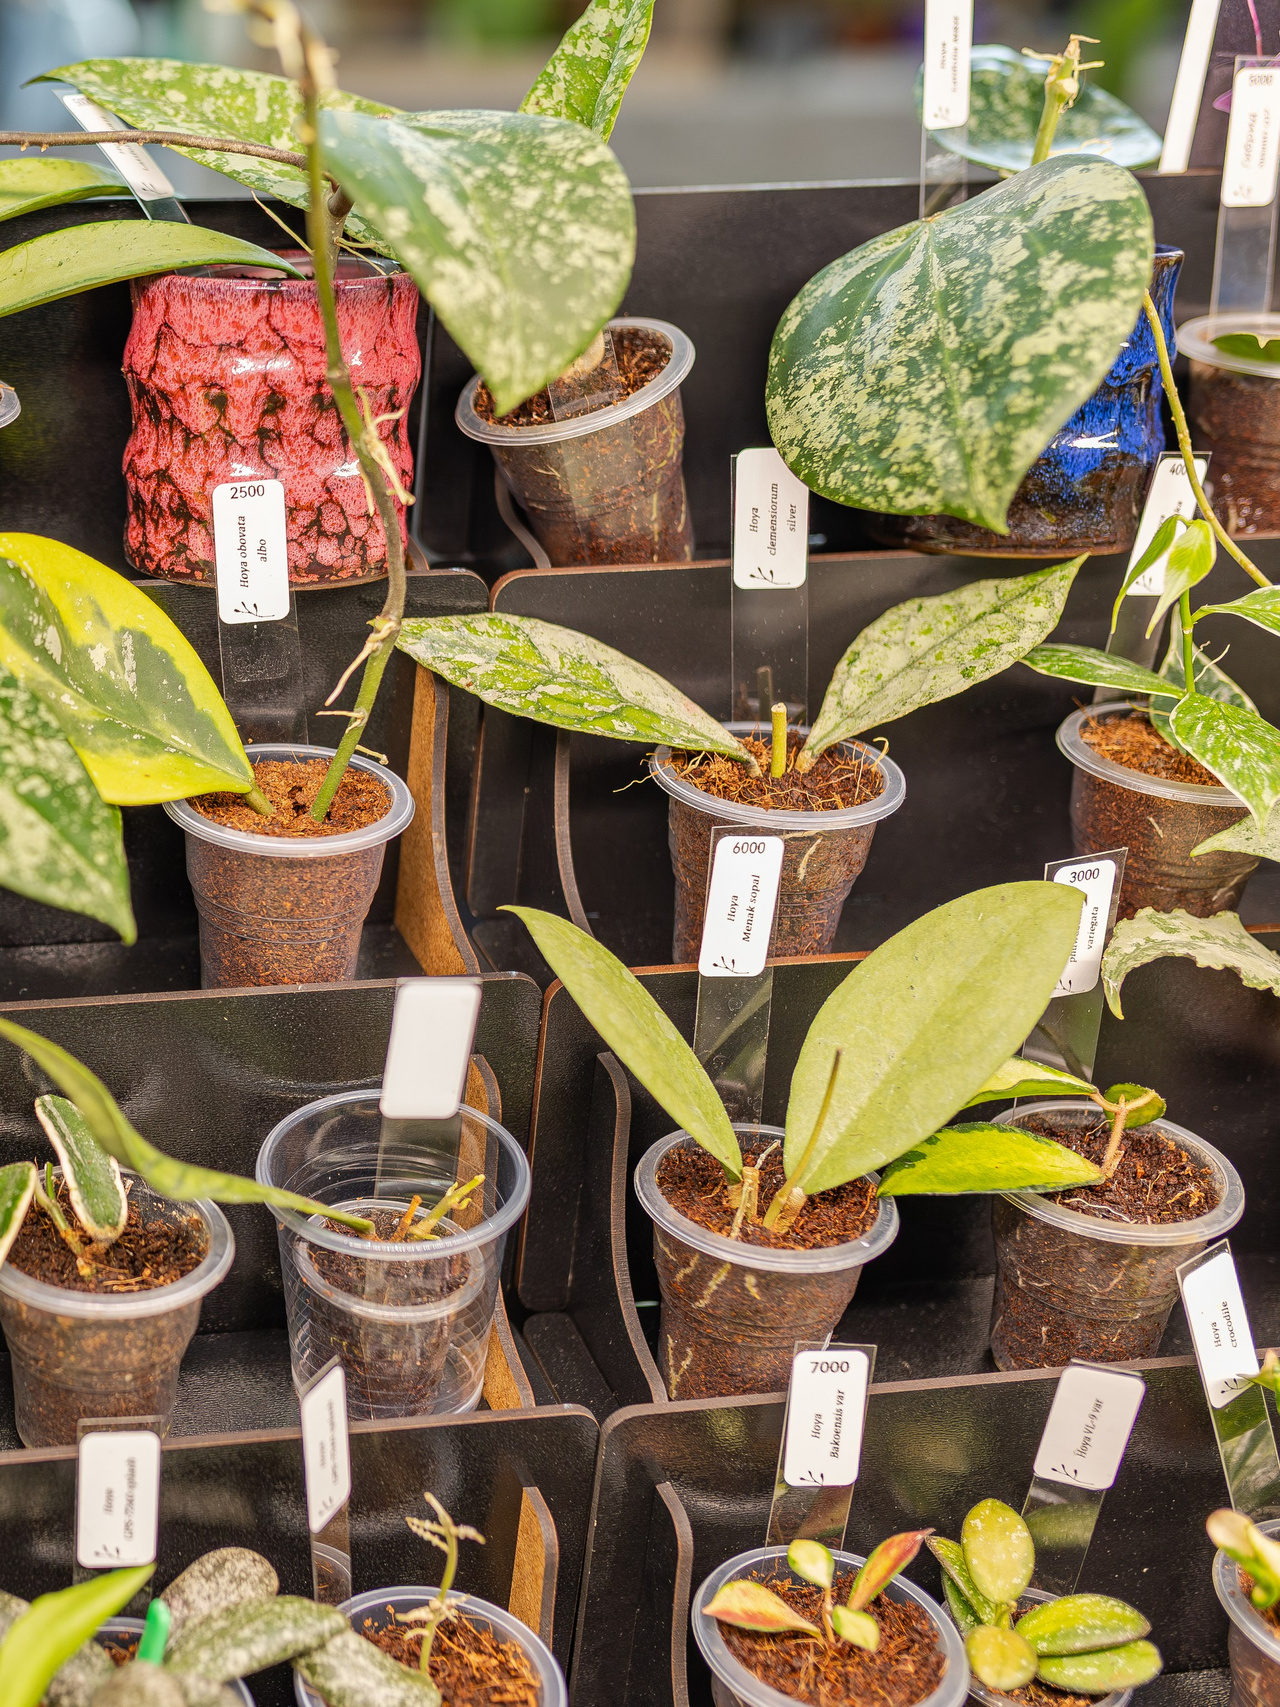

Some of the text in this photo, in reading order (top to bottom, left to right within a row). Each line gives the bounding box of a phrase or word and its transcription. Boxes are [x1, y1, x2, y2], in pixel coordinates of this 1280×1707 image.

[1169, 463, 1189, 476] 400
[230, 484, 265, 499] 2500
[749, 507, 761, 533] Hoya
[767, 483, 778, 556] clemensiorum
[786, 503, 797, 532] silver
[237, 515, 251, 588] Hoya obovata
[256, 538, 268, 562] albo
[732, 841, 766, 854] 6000
[1069, 868, 1100, 883] 3000
[727, 895, 740, 922] Hoya
[742, 874, 762, 942] Menak sopal
[1087, 906, 1099, 950] variegata
[1210, 1321, 1222, 1348] Hoya
[1221, 1300, 1238, 1348] crocodile
[810, 1361, 850, 1374] 7000
[811, 1413, 824, 1439] Hoya
[830, 1389, 845, 1459] Bakoensis var
[1074, 1435, 1092, 1459] Hoya
[1091, 1397, 1104, 1413] var
